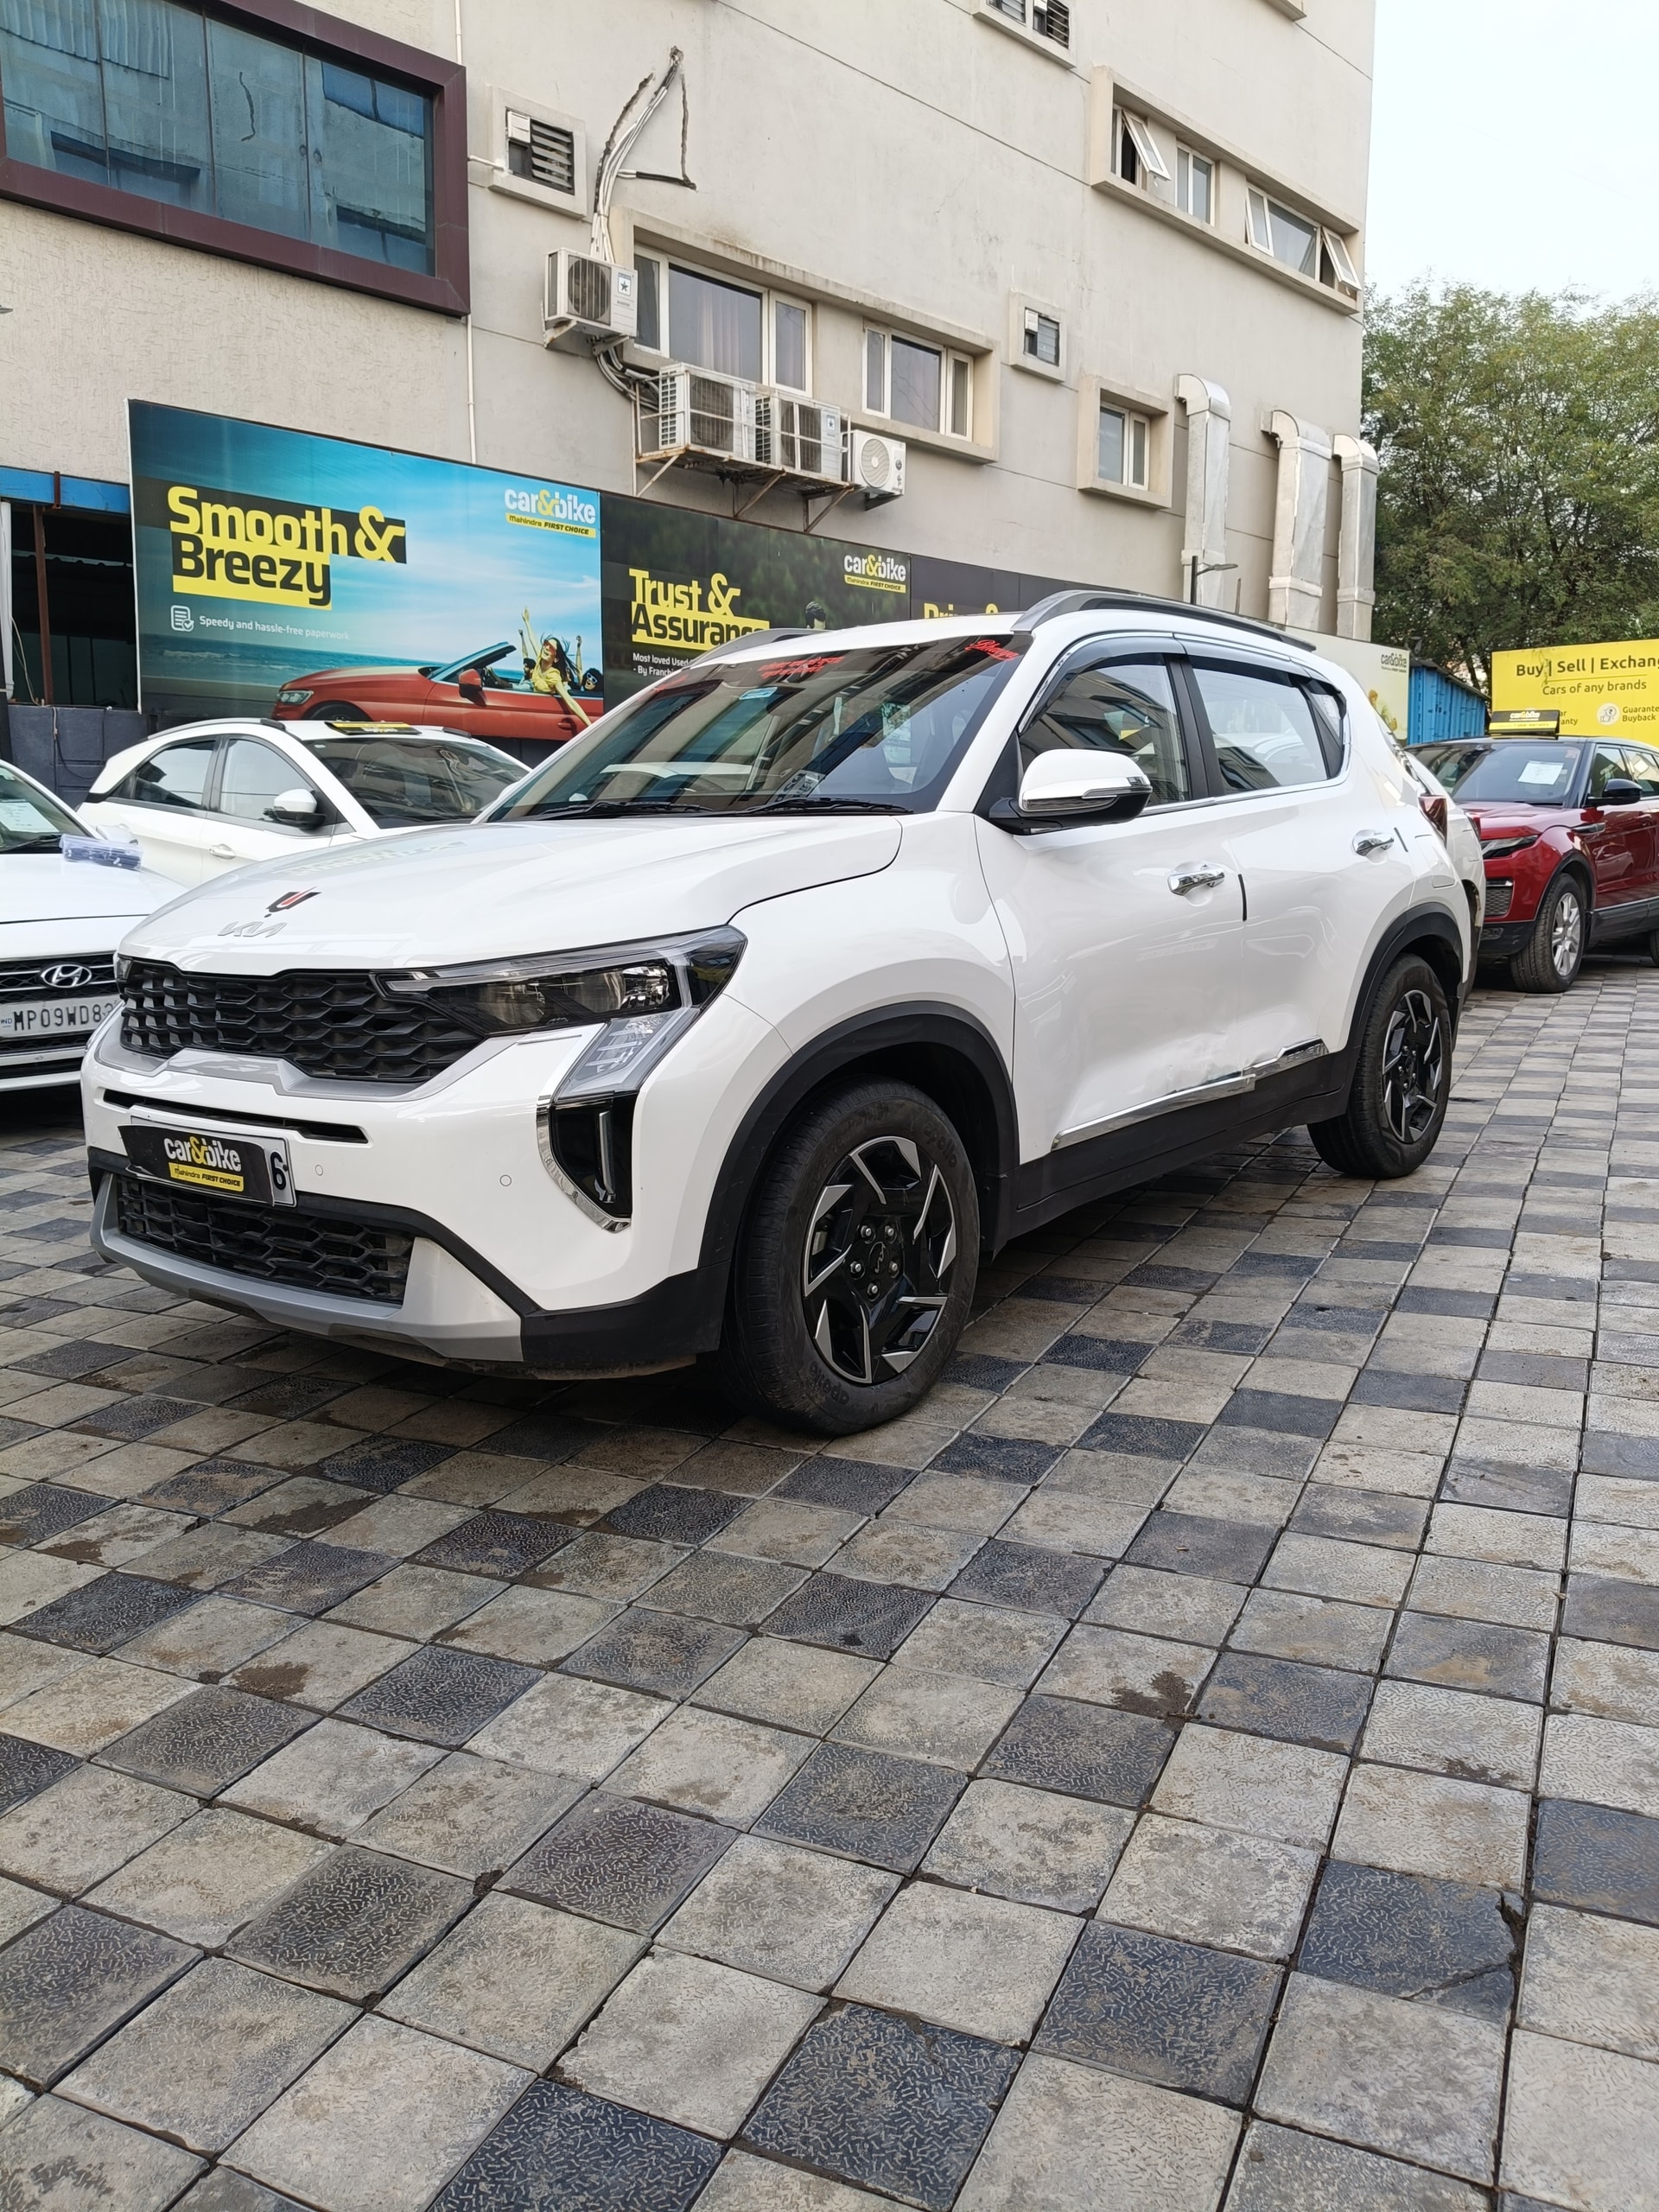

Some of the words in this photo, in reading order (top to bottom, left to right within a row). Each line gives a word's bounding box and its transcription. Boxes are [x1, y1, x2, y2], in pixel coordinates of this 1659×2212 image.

[505, 489, 596, 524] car&bike
[167, 486, 348, 556] Smooth
[354, 505, 405, 563] &
[543, 522, 564, 531] FIRST
[564, 525, 589, 535] CHOICE
[173, 533, 331, 607] Breezy
[843, 554, 906, 582] car&bike
[629, 568, 702, 612] Trust
[708, 573, 741, 617] &
[200, 615, 234, 630] Speedy
[236, 620, 253, 630] and
[255, 621, 303, 635] hassle-free
[305, 629, 349, 640] paperwork
[631, 603, 765, 646] Assuran
[632, 652, 651, 662] Most
[652, 654, 671, 664] loved
[638, 665, 648, 677] By
[1516, 662, 1544, 677] Buy
[1557, 658, 1586, 673] Sell
[1542, 684, 1567, 696] Cars
[1569, 683, 1582, 694] of
[1584, 683, 1605, 694] any
[1607, 679, 1647, 691] brands
[1622, 714, 1656, 723] Buyback
[218, 921, 288, 938] KIA
[14, 1001, 118, 1031] MP09WD8
[163, 1136, 242, 1172] car&bike
[202, 1173, 219, 1183] FIRST
[219, 1177, 241, 1187] CHOICE
[270, 1151, 287, 1191] 6
